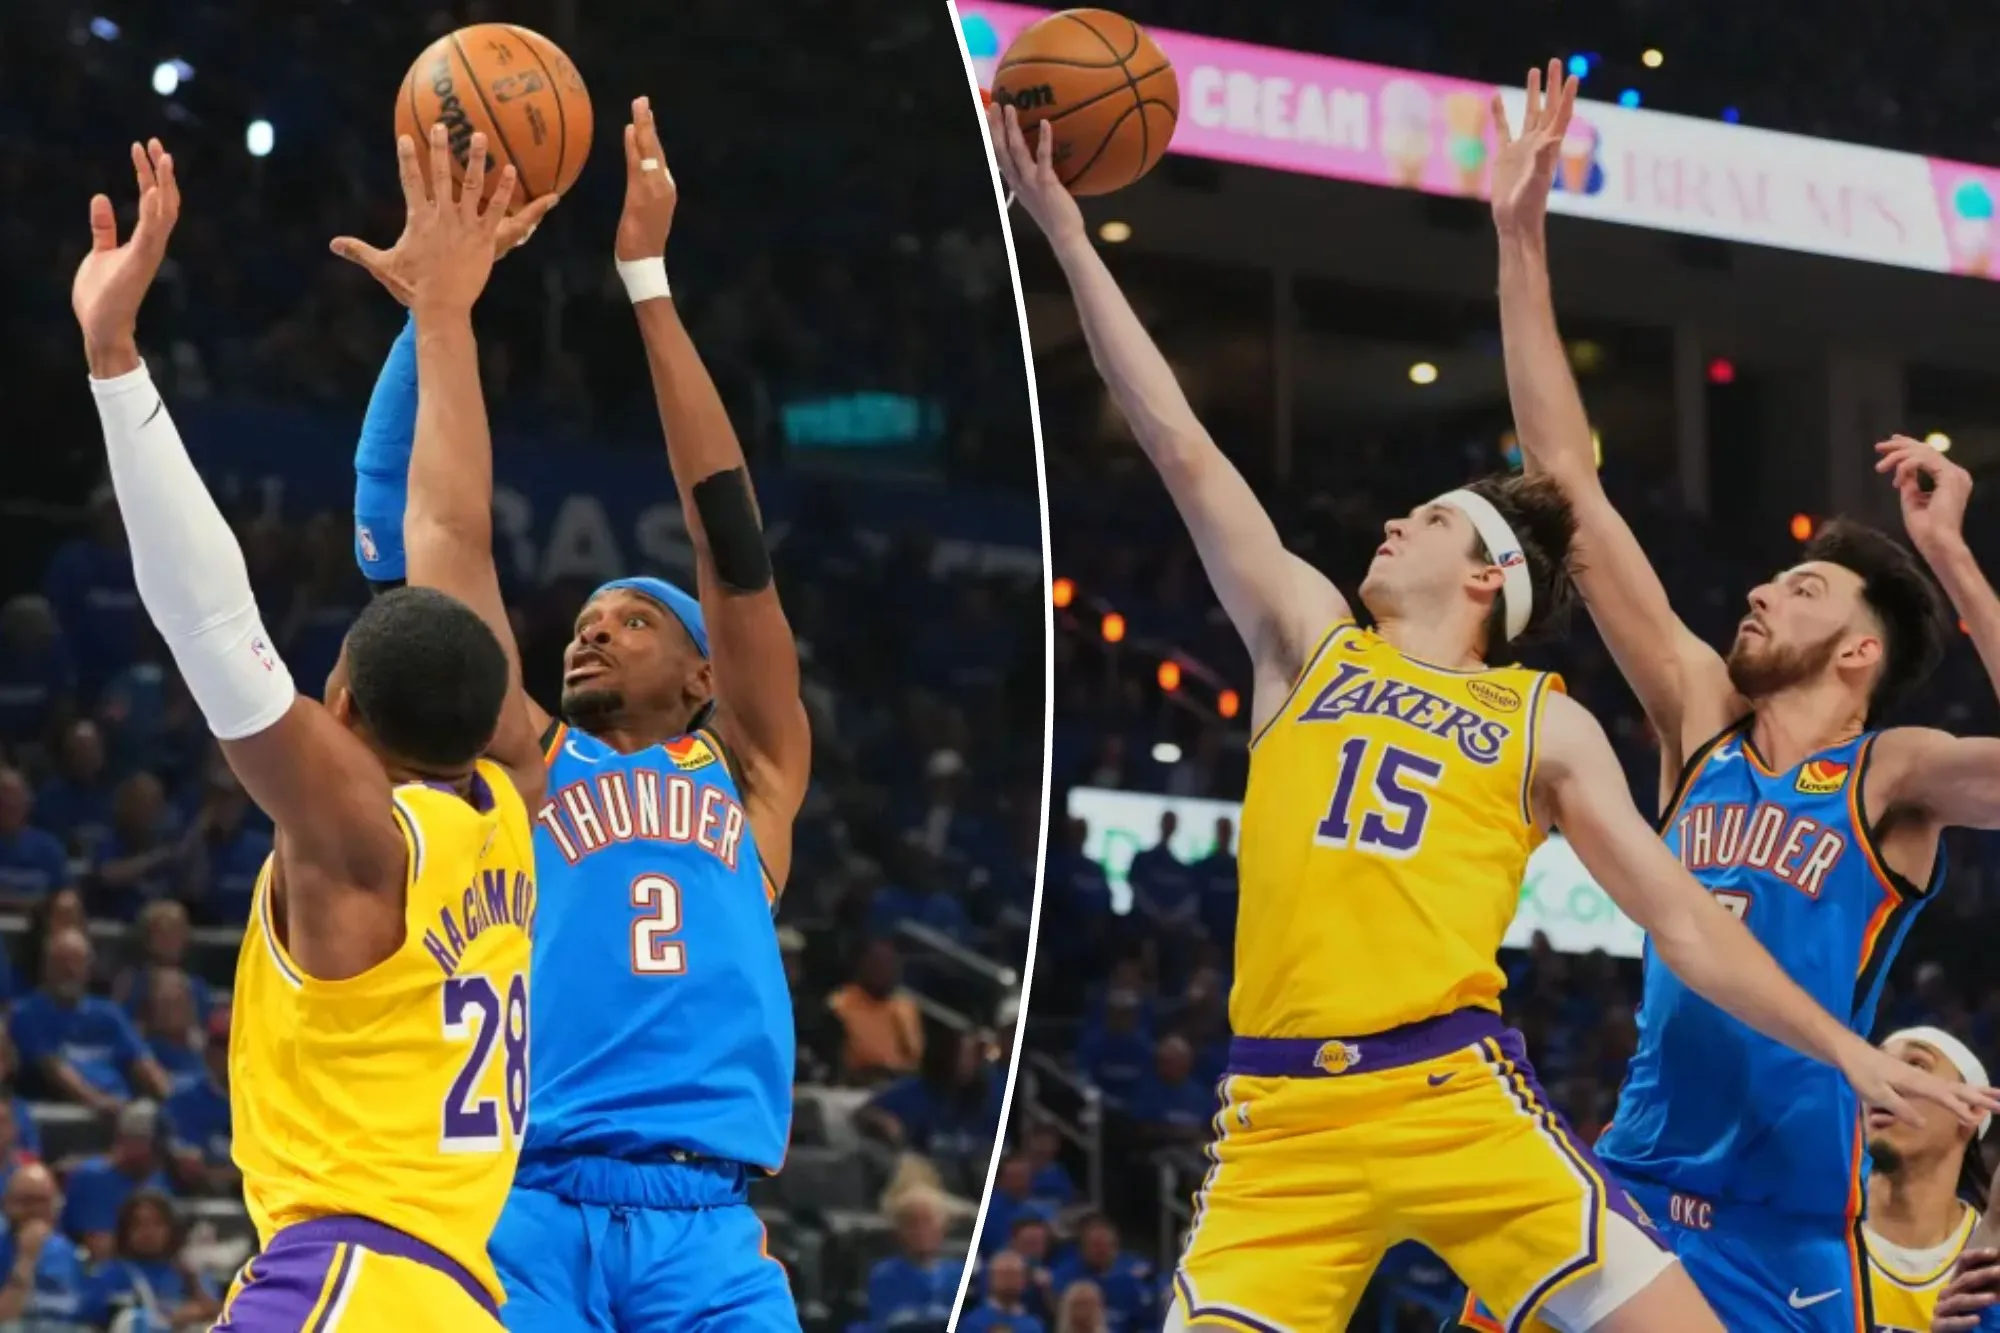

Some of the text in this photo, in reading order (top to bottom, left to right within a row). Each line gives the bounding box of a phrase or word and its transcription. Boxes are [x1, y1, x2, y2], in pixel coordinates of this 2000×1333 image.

[1188, 65, 1369, 152] CREAM
[1297, 661, 1512, 765] LAKERS
[537, 767, 746, 871] THUNDER
[1312, 736, 1443, 858] 15
[1678, 803, 1846, 899] THUDER
[631, 872, 687, 976] 2
[439, 971, 531, 1153] 28
[1669, 1193, 1713, 1229] OKC
